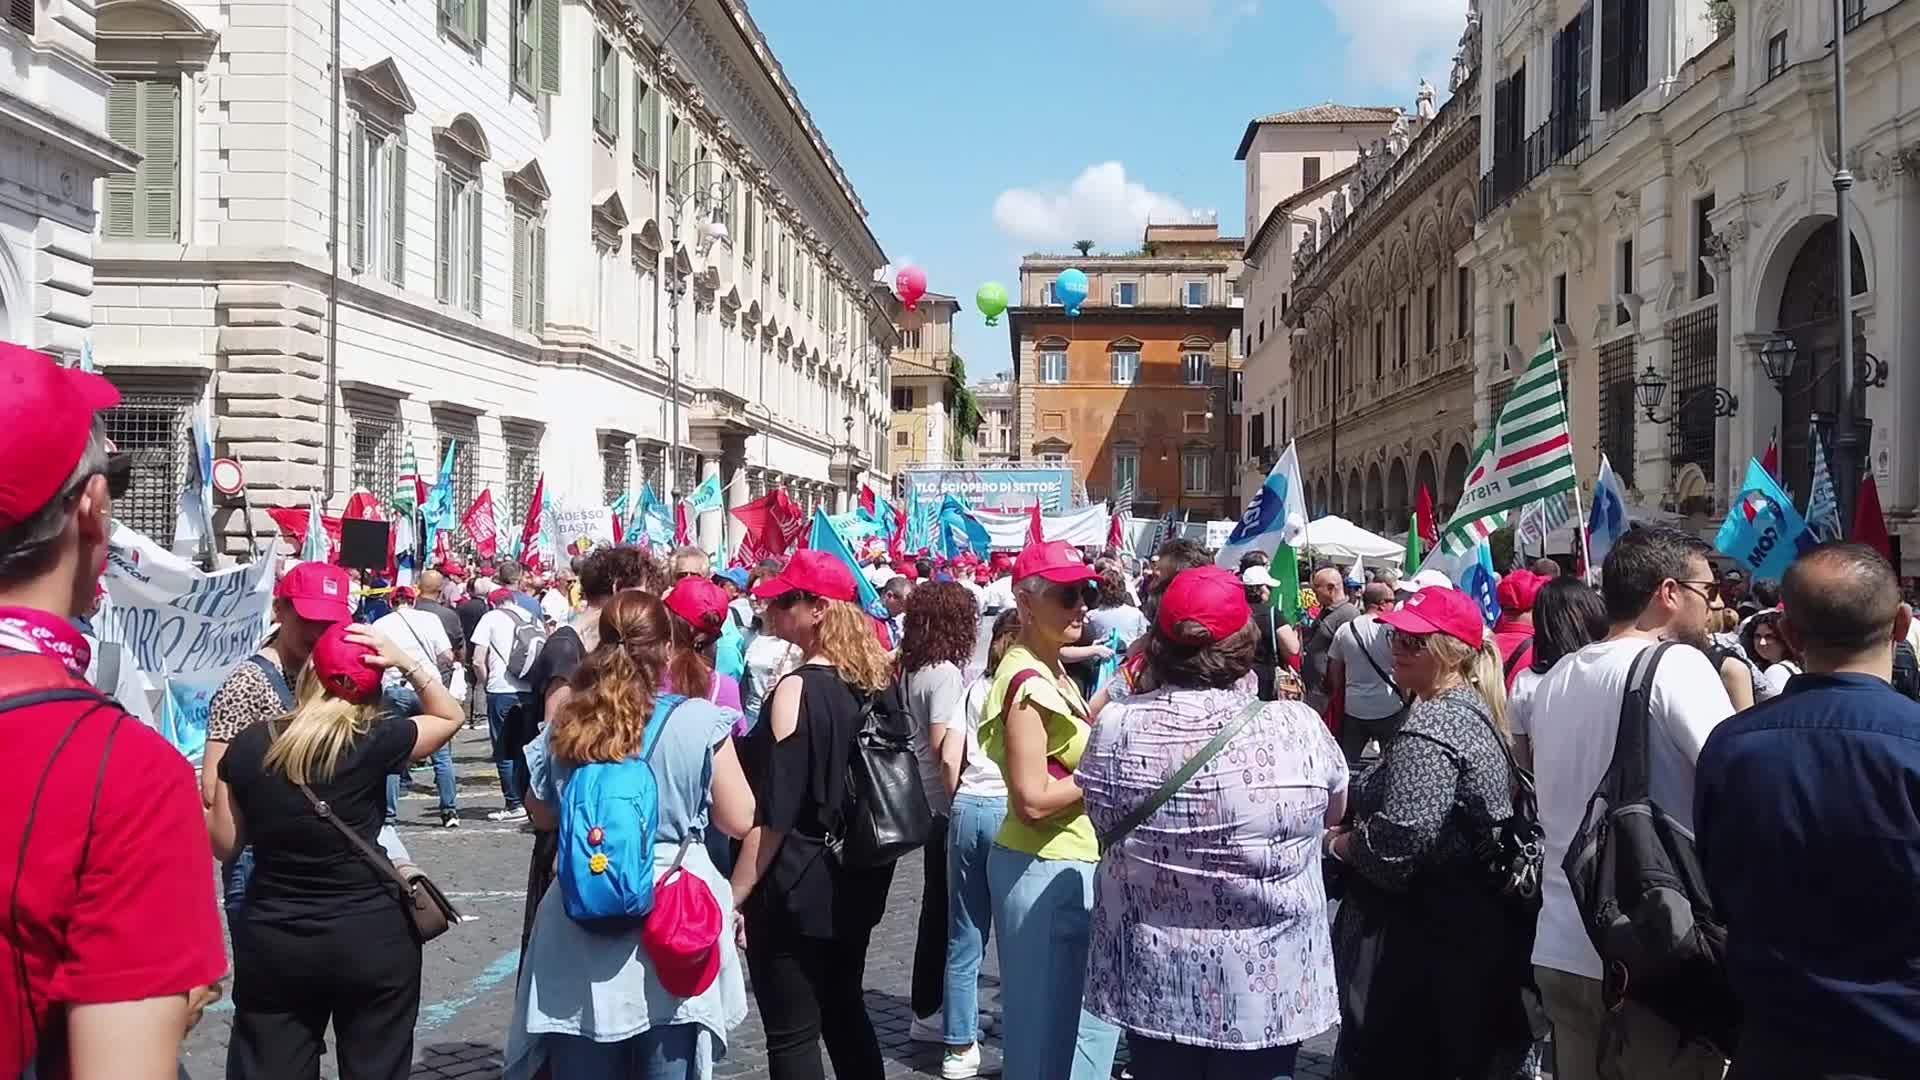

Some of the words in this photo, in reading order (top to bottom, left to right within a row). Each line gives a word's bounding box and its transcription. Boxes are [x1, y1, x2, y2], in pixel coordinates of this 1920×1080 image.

[941, 482, 997, 494] SCIOPERO
[1000, 482, 1012, 493] DI
[1013, 482, 1057, 494] SETTOR
[557, 509, 604, 522] ADESSO
[559, 522, 599, 534] BASTA
